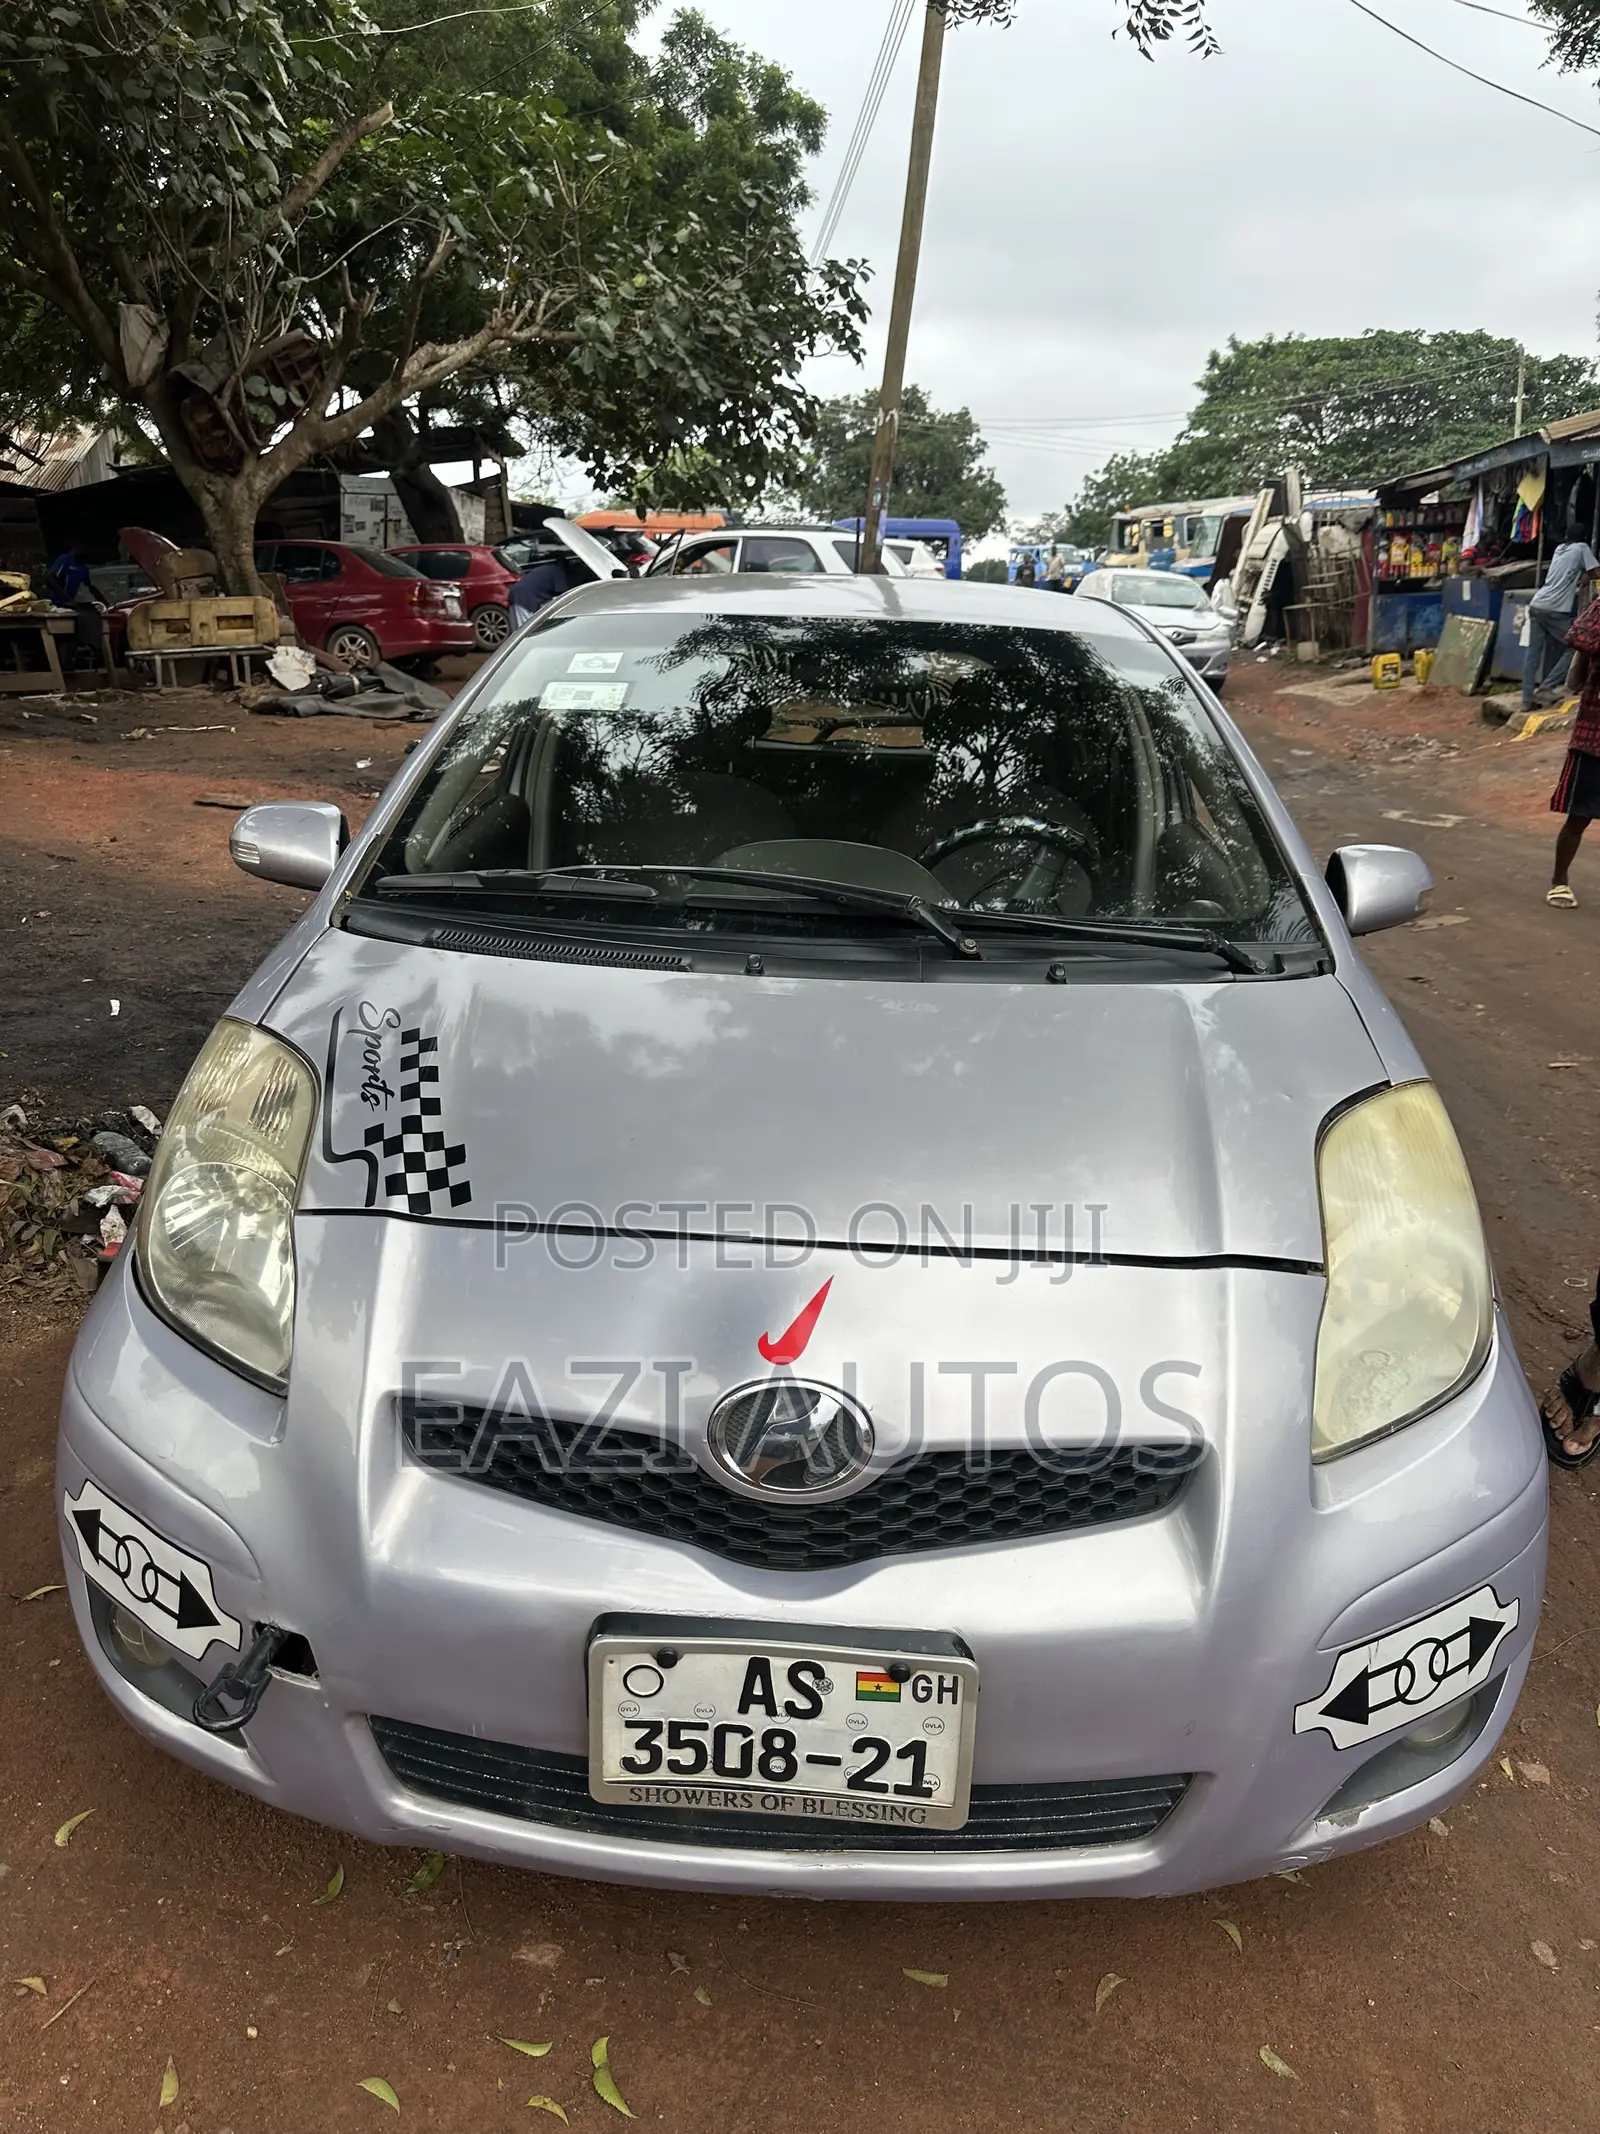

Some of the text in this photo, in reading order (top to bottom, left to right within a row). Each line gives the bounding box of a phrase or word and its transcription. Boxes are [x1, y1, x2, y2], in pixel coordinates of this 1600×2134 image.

[346, 1001, 401, 1112] Sports
[738, 1656, 826, 1720] AS
[911, 1674, 959, 1705] GH
[629, 1786, 928, 1826] SHOWERS OF BLESSING
